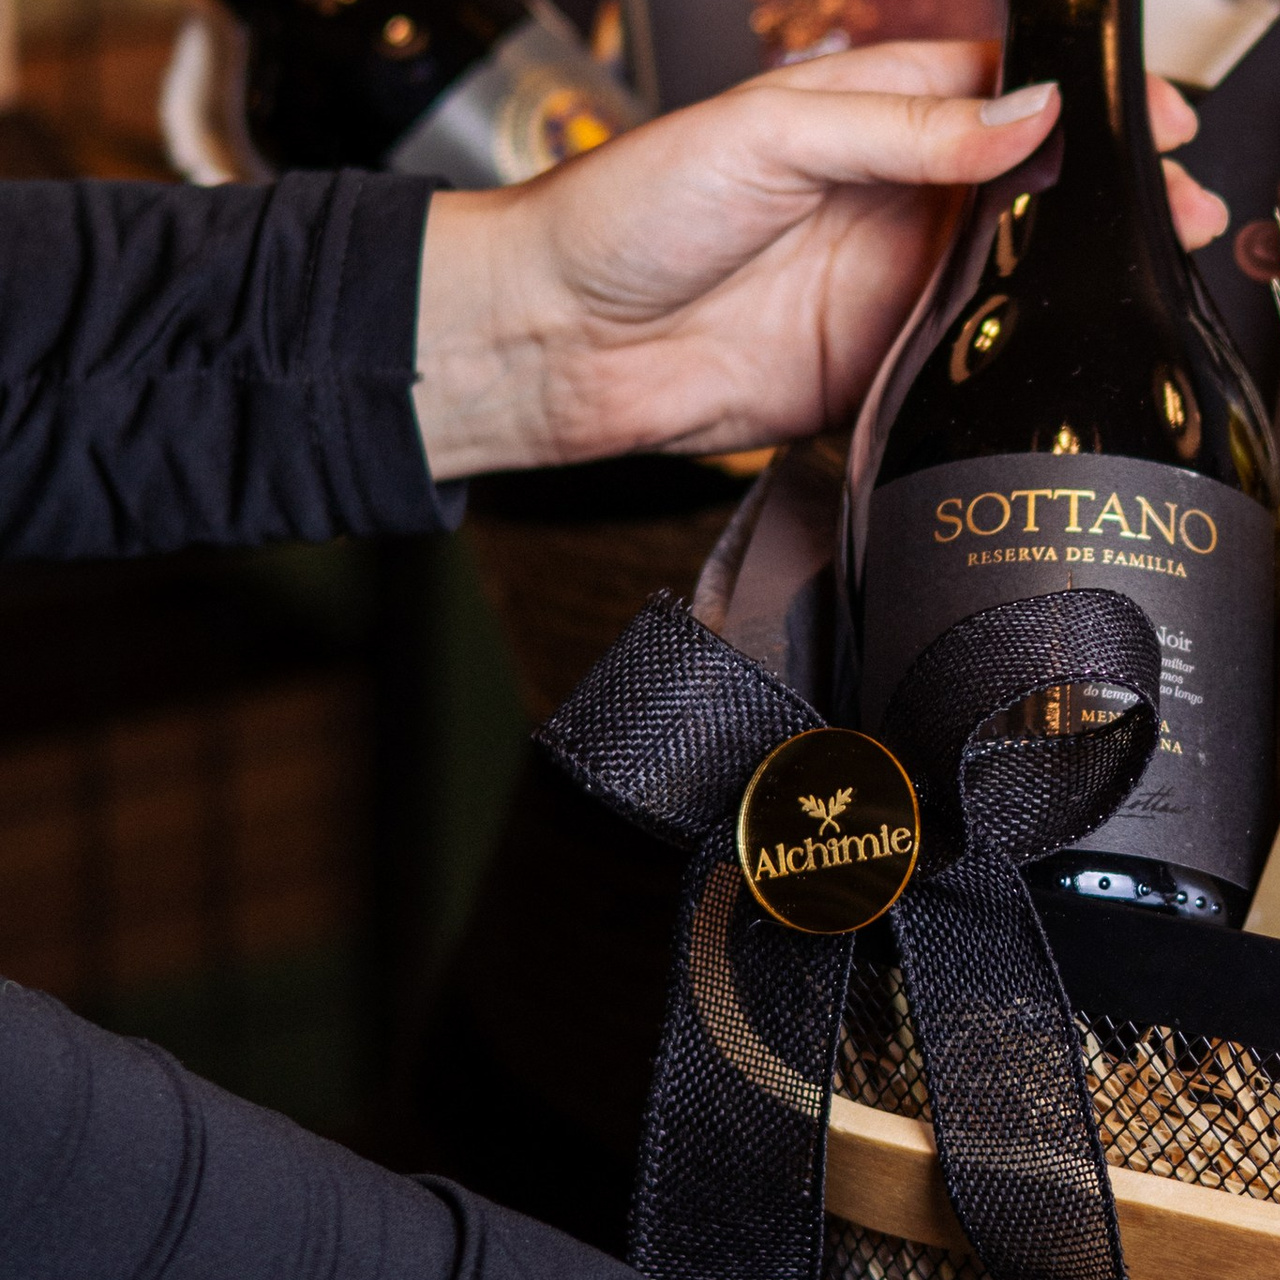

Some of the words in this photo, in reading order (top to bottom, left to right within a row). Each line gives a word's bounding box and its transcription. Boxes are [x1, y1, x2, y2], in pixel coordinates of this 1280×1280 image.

[934, 489, 1218, 554] SOTTANO
[967, 546, 1058, 566] RESERVA
[1066, 547, 1095, 562] DE
[1102, 549, 1187, 578] FAMILIA
[1083, 685, 1099, 697] do
[1174, 686, 1203, 705] longo
[754, 823, 913, 881] Alchimie
